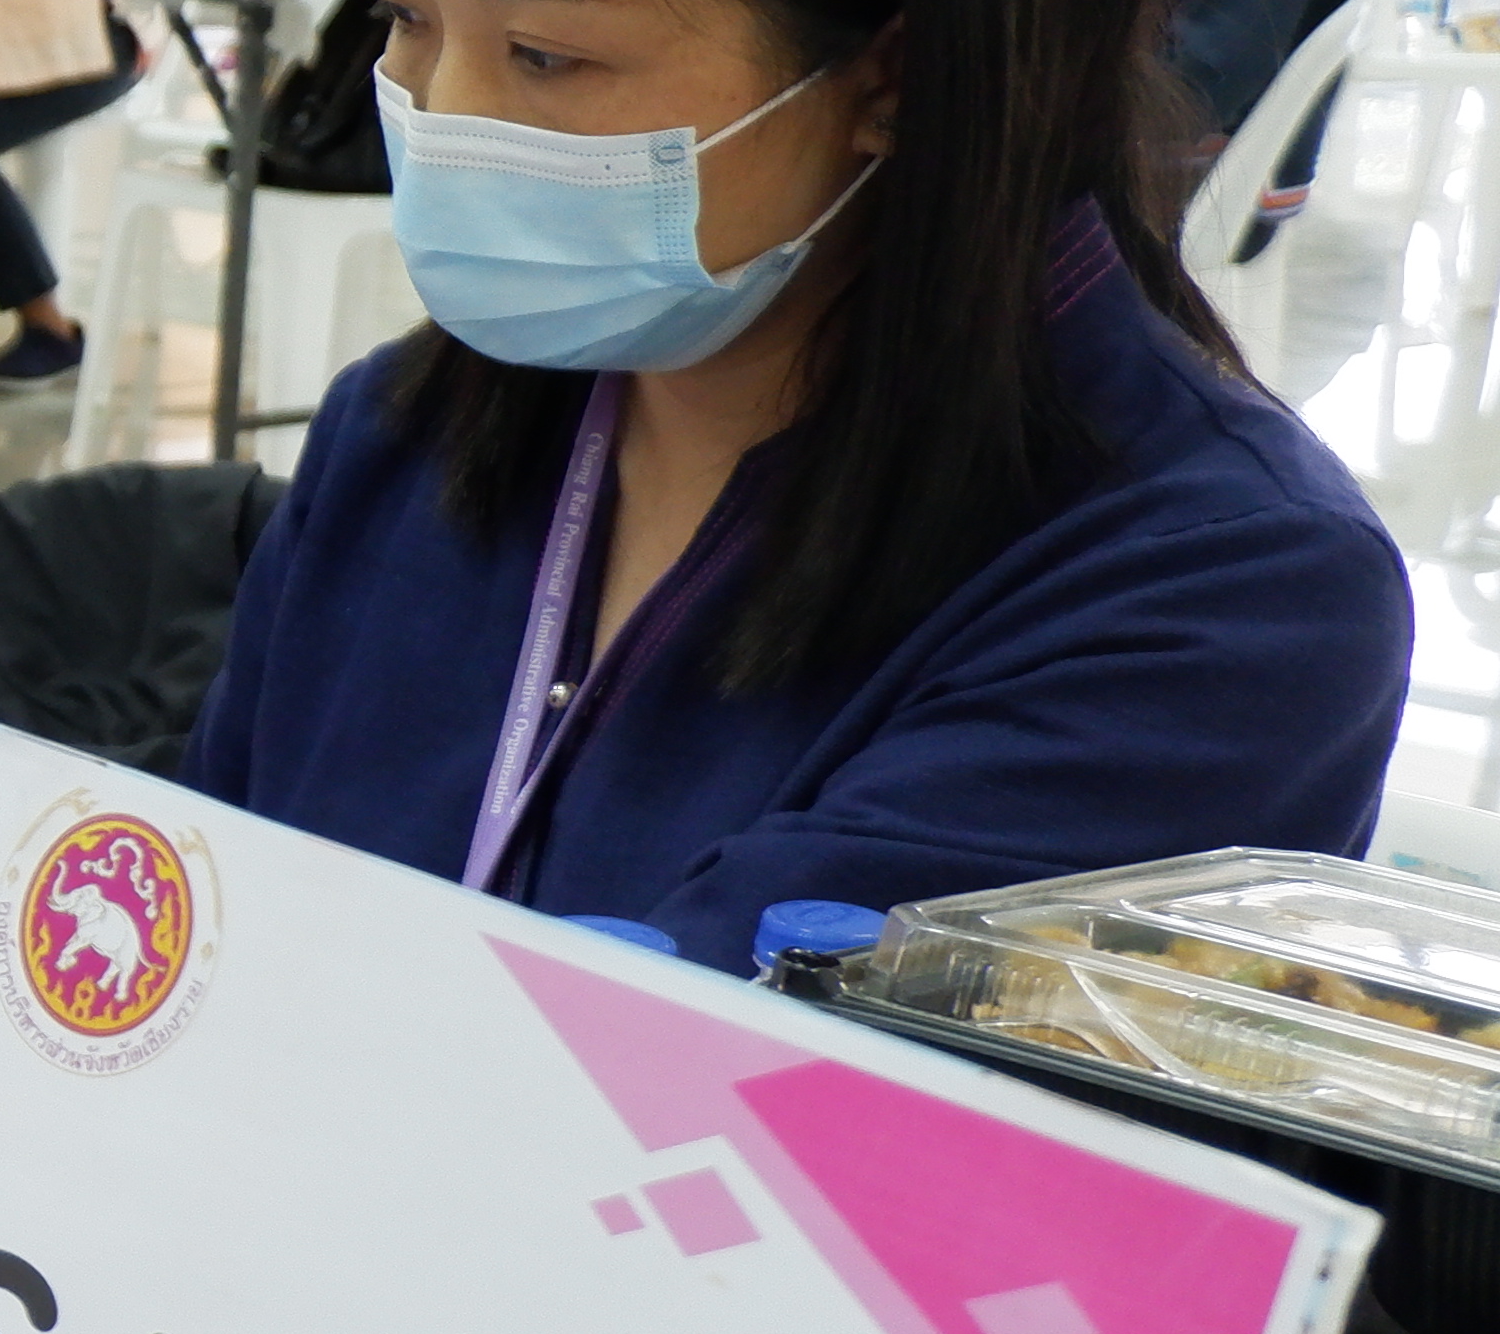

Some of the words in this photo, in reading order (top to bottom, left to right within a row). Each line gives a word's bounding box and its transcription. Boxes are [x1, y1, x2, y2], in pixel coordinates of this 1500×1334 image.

[573, 432, 604, 485] Chiang
[567, 491, 588, 518] Rai
[546, 522, 580, 597] Provincial
[517, 602, 558, 713] Administrative
[490, 718, 529, 814] Organization
